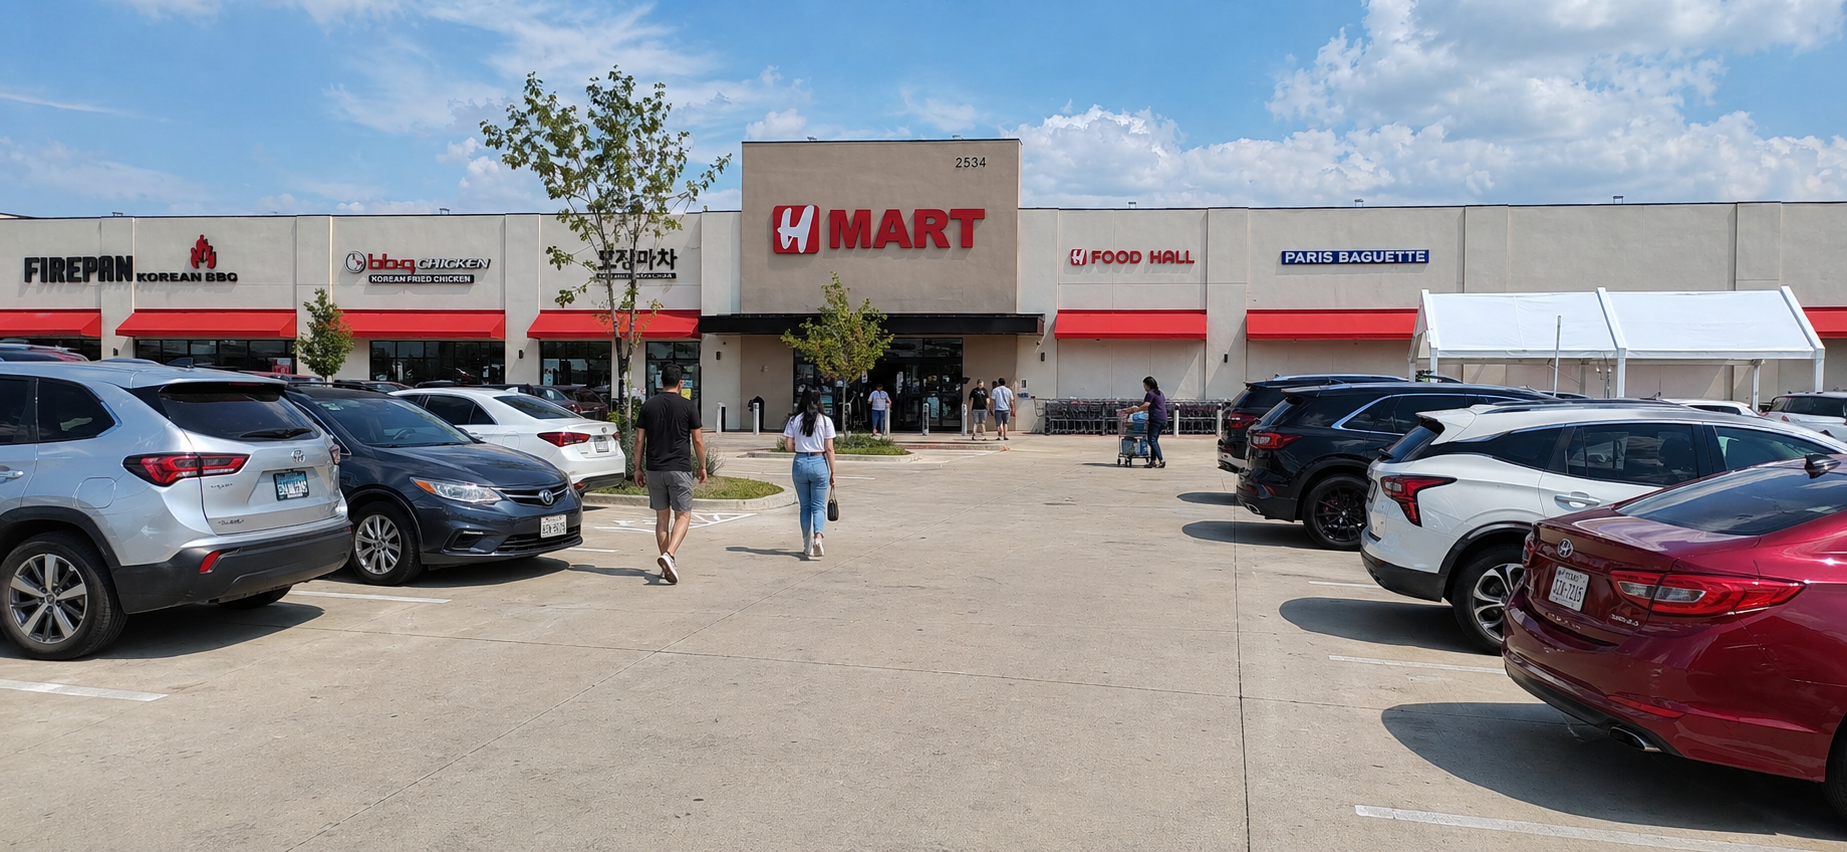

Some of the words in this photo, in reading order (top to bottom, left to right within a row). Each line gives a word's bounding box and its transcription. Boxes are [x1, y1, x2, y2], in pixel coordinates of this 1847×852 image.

[955, 157, 987, 169] 2534
[775, 204, 816, 254] H
[830, 208, 986, 249] MART
[417, 258, 491, 269] CHICKEN
[1071, 249, 1087, 265] H
[1091, 250, 1142, 264] FOOD
[1149, 250, 1195, 264] HALL
[1285, 252, 1333, 263] PARIS
[1339, 251, 1425, 263] BAGUETTE
[24, 256, 133, 283] FIREPAN
[136, 272, 202, 282] KOREAN
[205, 272, 238, 282] BBQ
